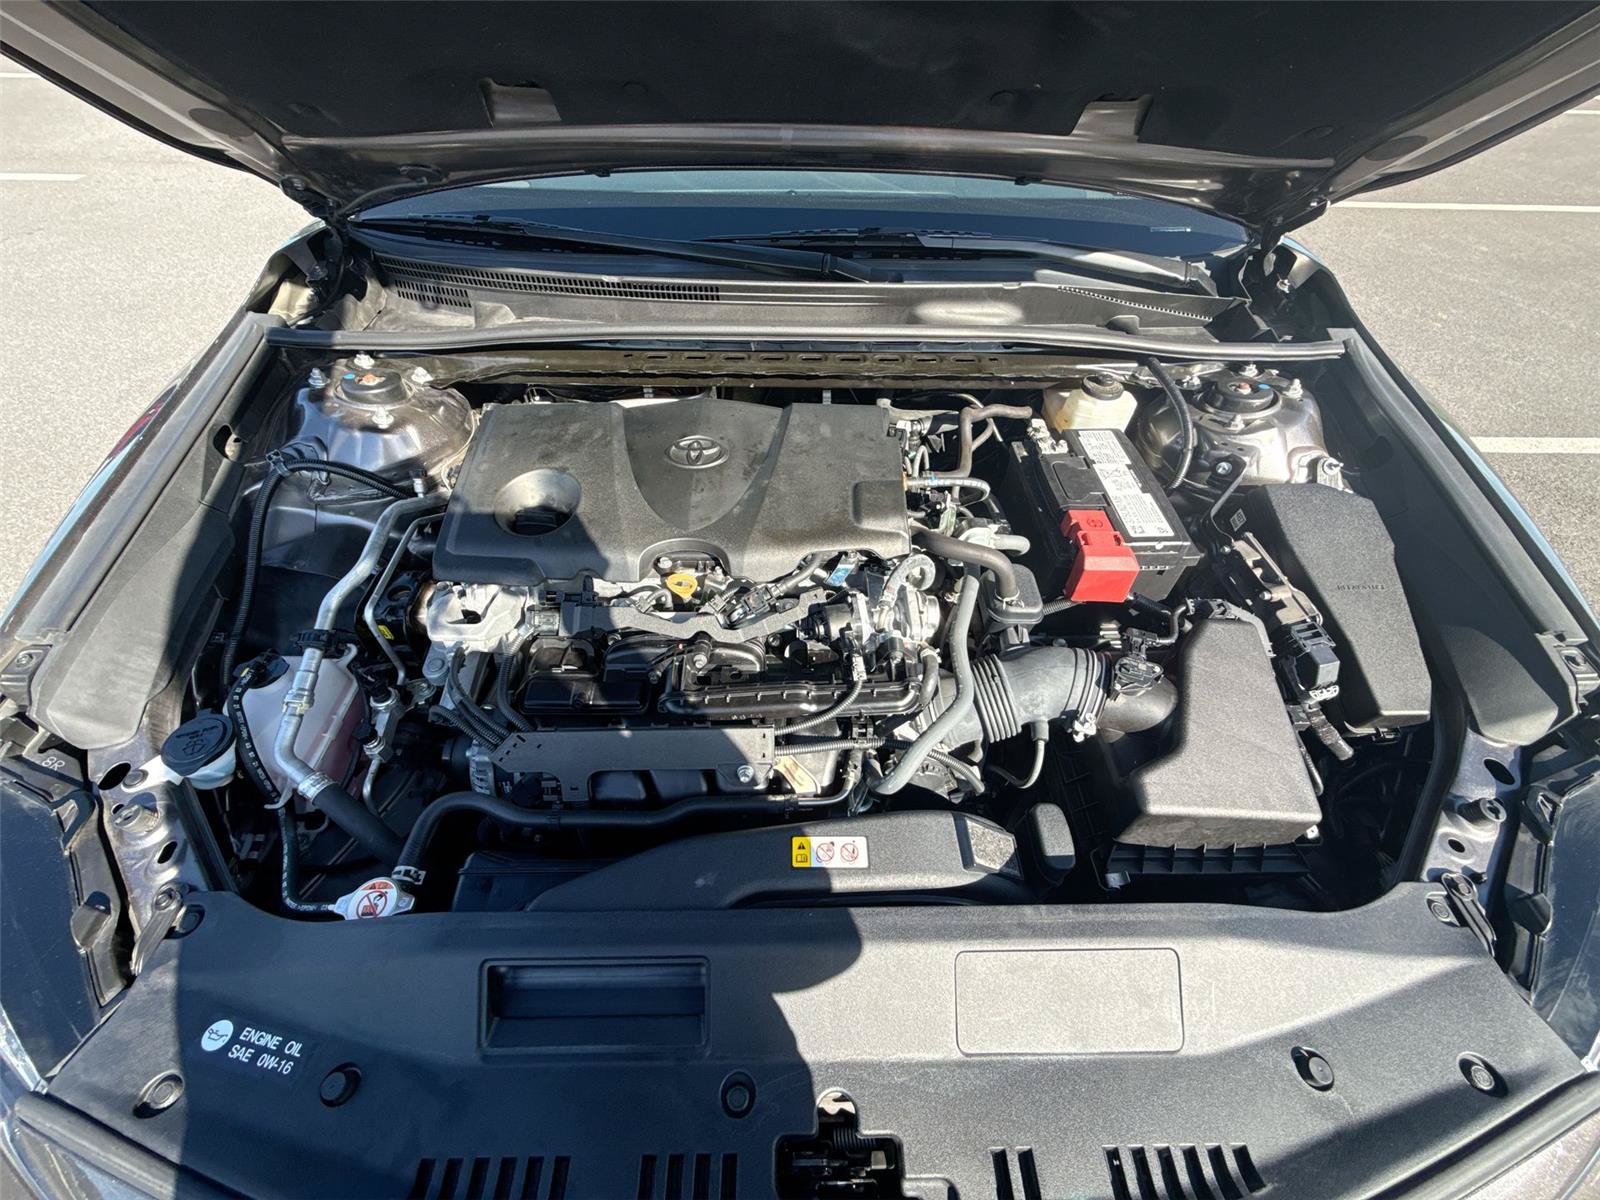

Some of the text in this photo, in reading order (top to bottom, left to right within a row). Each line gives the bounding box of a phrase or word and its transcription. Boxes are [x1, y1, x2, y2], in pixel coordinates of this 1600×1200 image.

[239, 1027, 303, 1057] ENGINE OIL
[228, 1044, 294, 1075] SAE 0W-16
